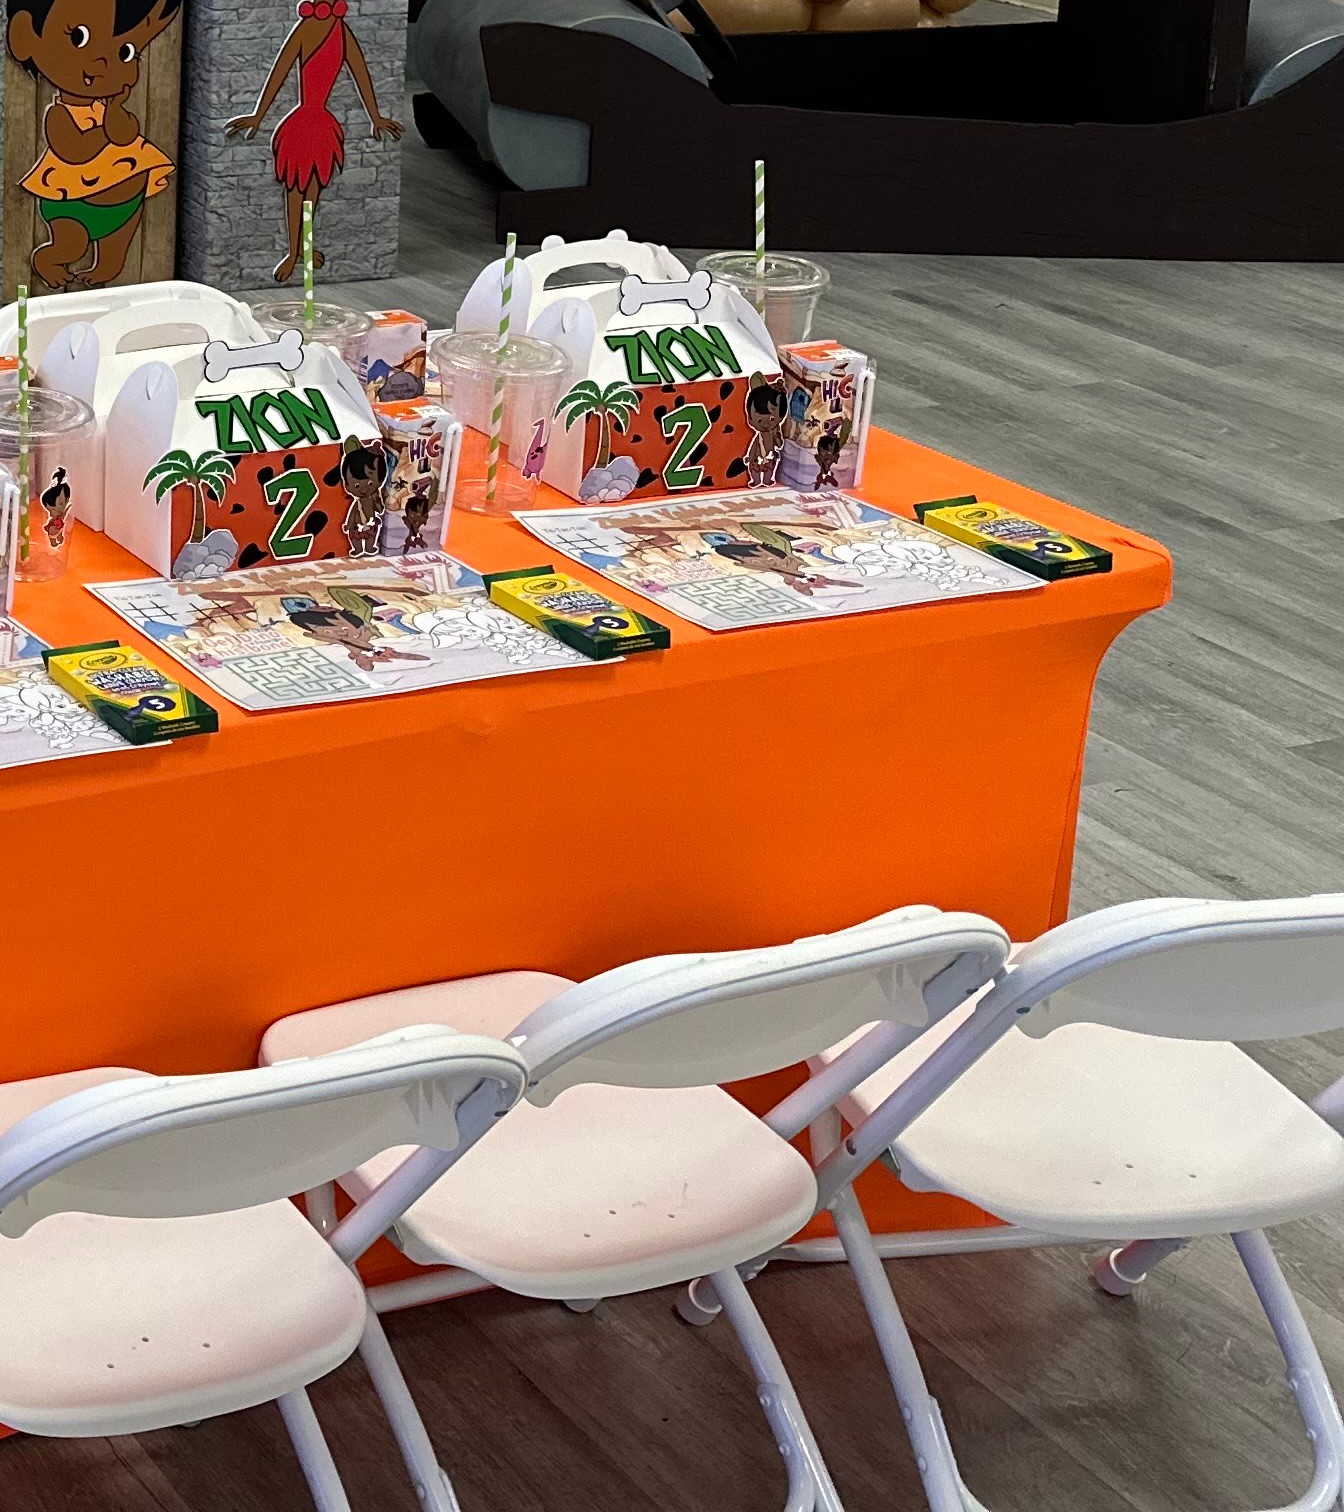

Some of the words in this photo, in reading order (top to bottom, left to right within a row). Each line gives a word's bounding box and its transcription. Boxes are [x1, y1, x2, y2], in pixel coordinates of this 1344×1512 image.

[604, 324, 743, 385] ZION
[195, 387, 341, 454] ZION
[661, 402, 712, 490] 2
[263, 468, 319, 561] 2
[602, 619, 620, 628] 5
[148, 699, 165, 710] 5
